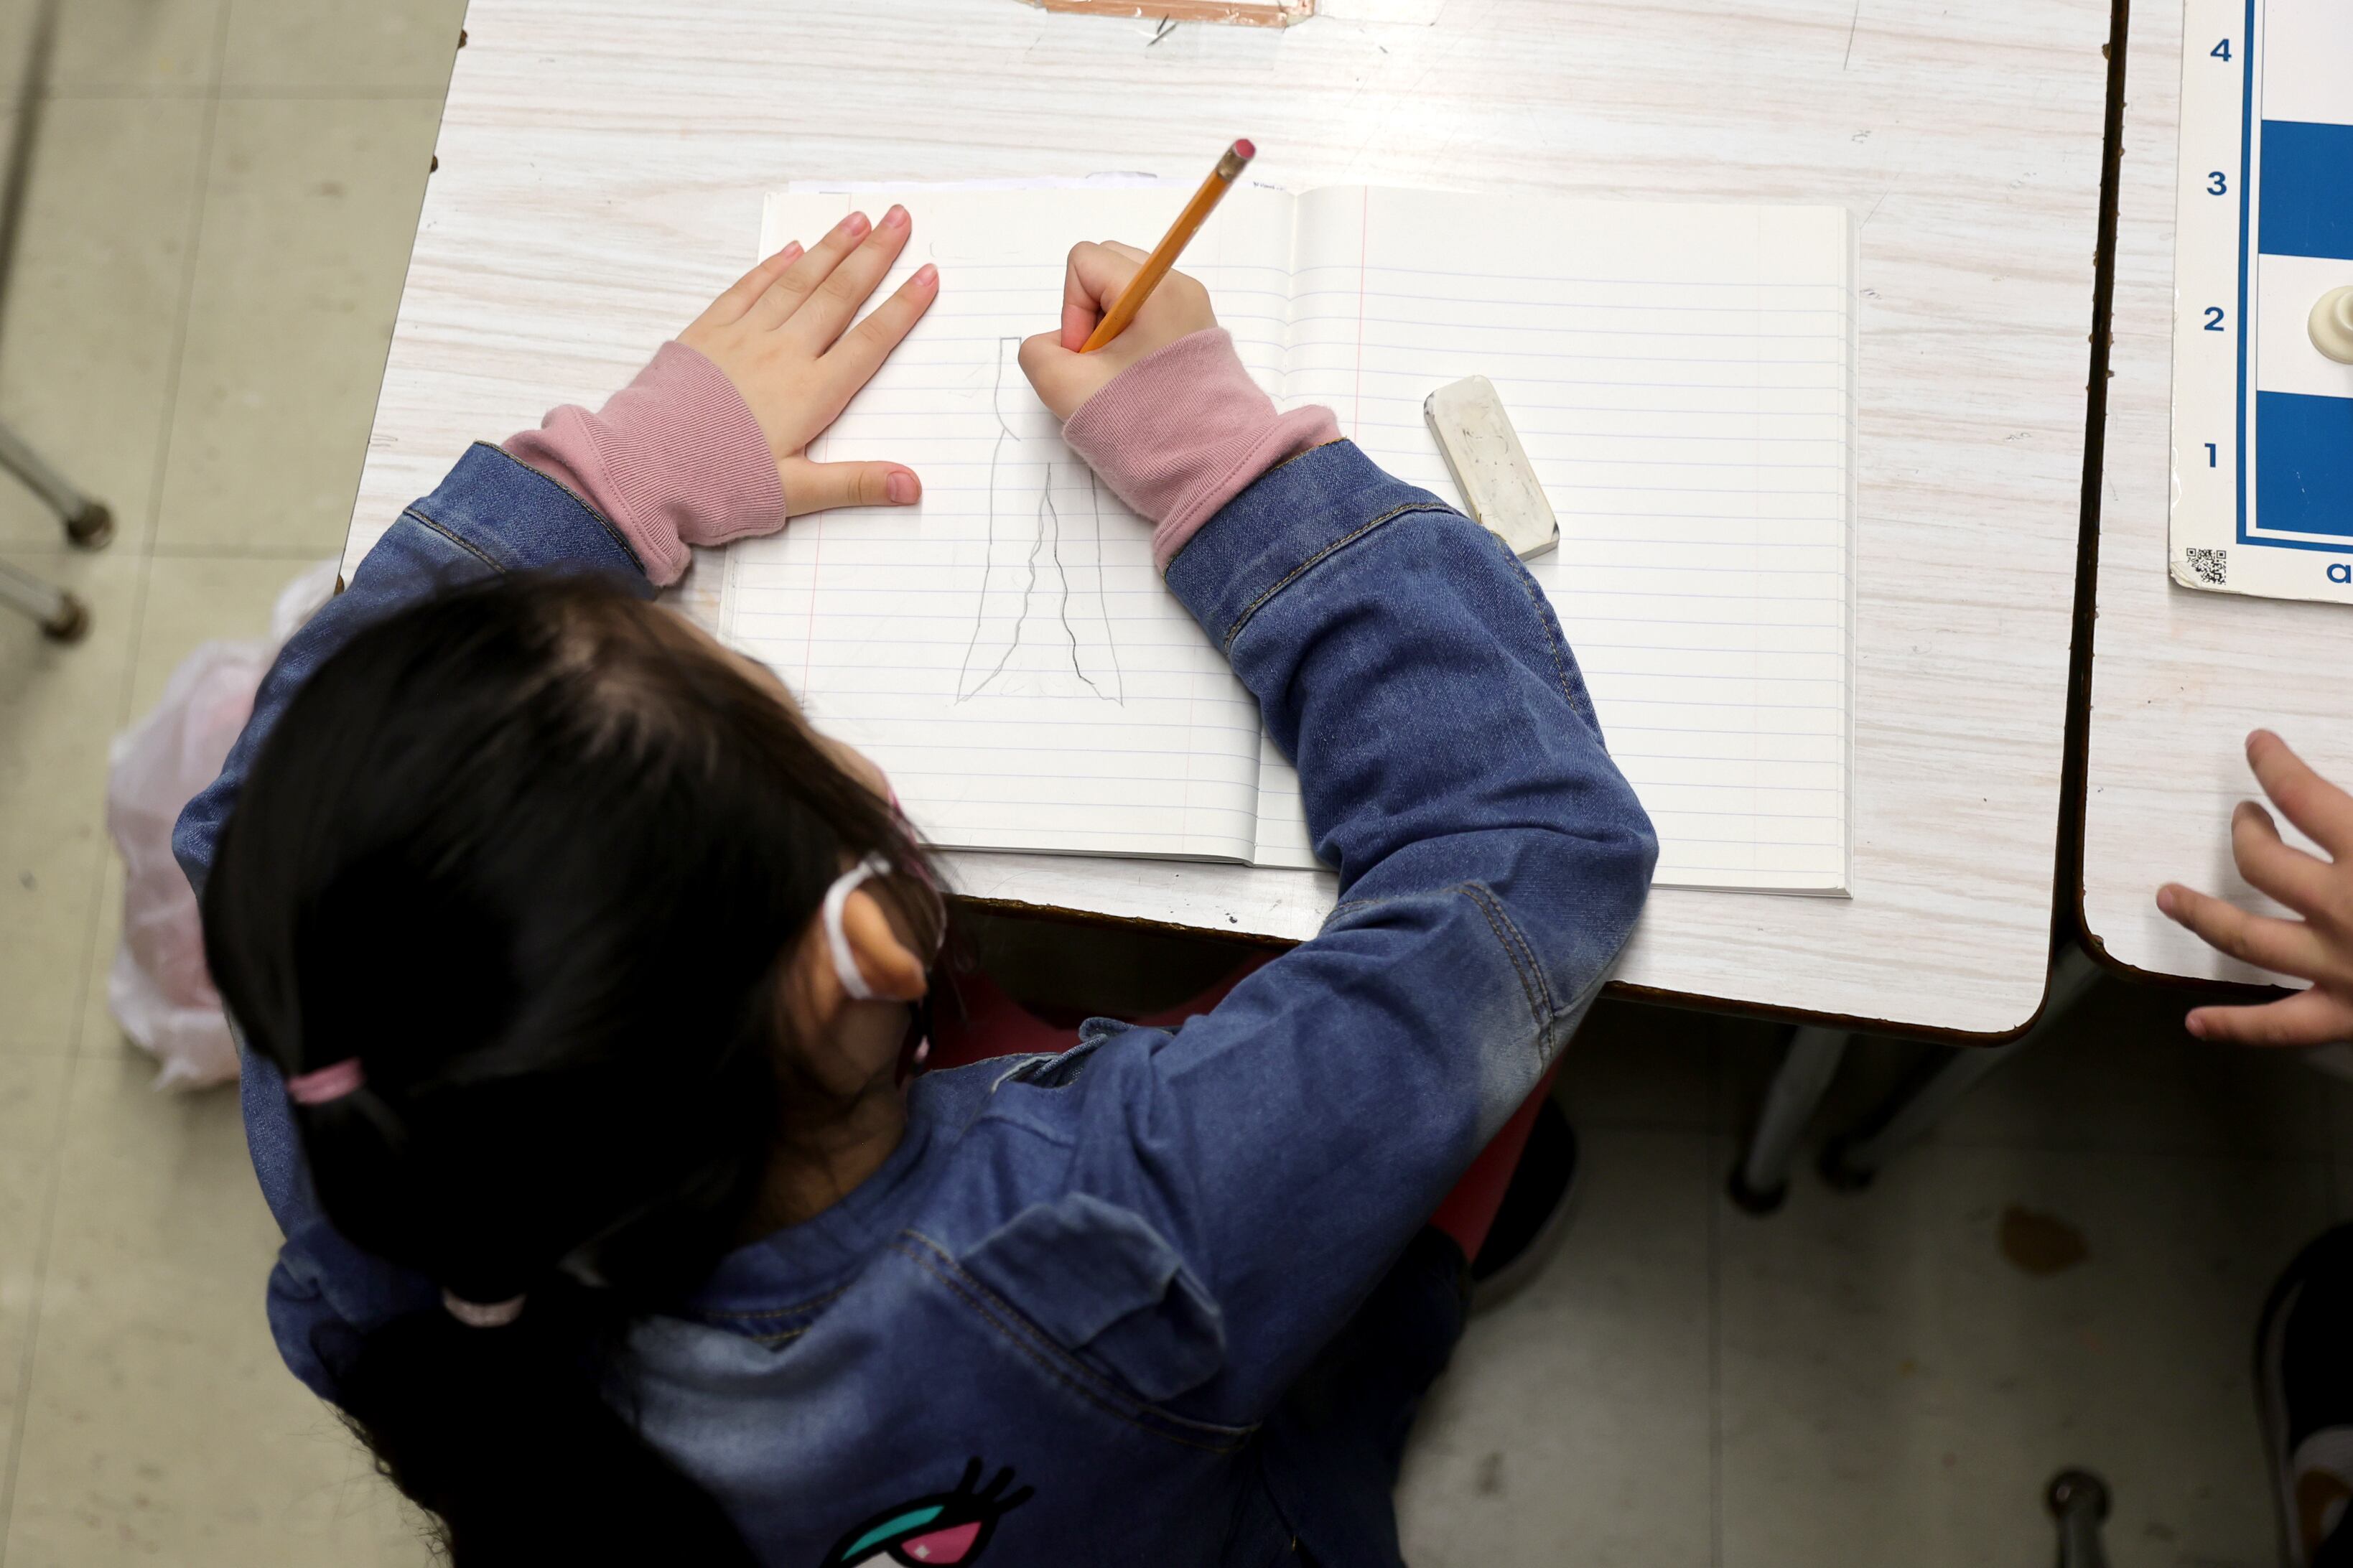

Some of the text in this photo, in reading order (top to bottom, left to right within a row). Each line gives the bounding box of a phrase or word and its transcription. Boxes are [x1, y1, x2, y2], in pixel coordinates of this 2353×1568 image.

[2209, 39, 2232, 62] 4
[2207, 172, 2227, 196] 3
[2204, 307, 2224, 331] 2
[2204, 443, 2217, 467] 1
[2326, 564, 2351, 584] a
